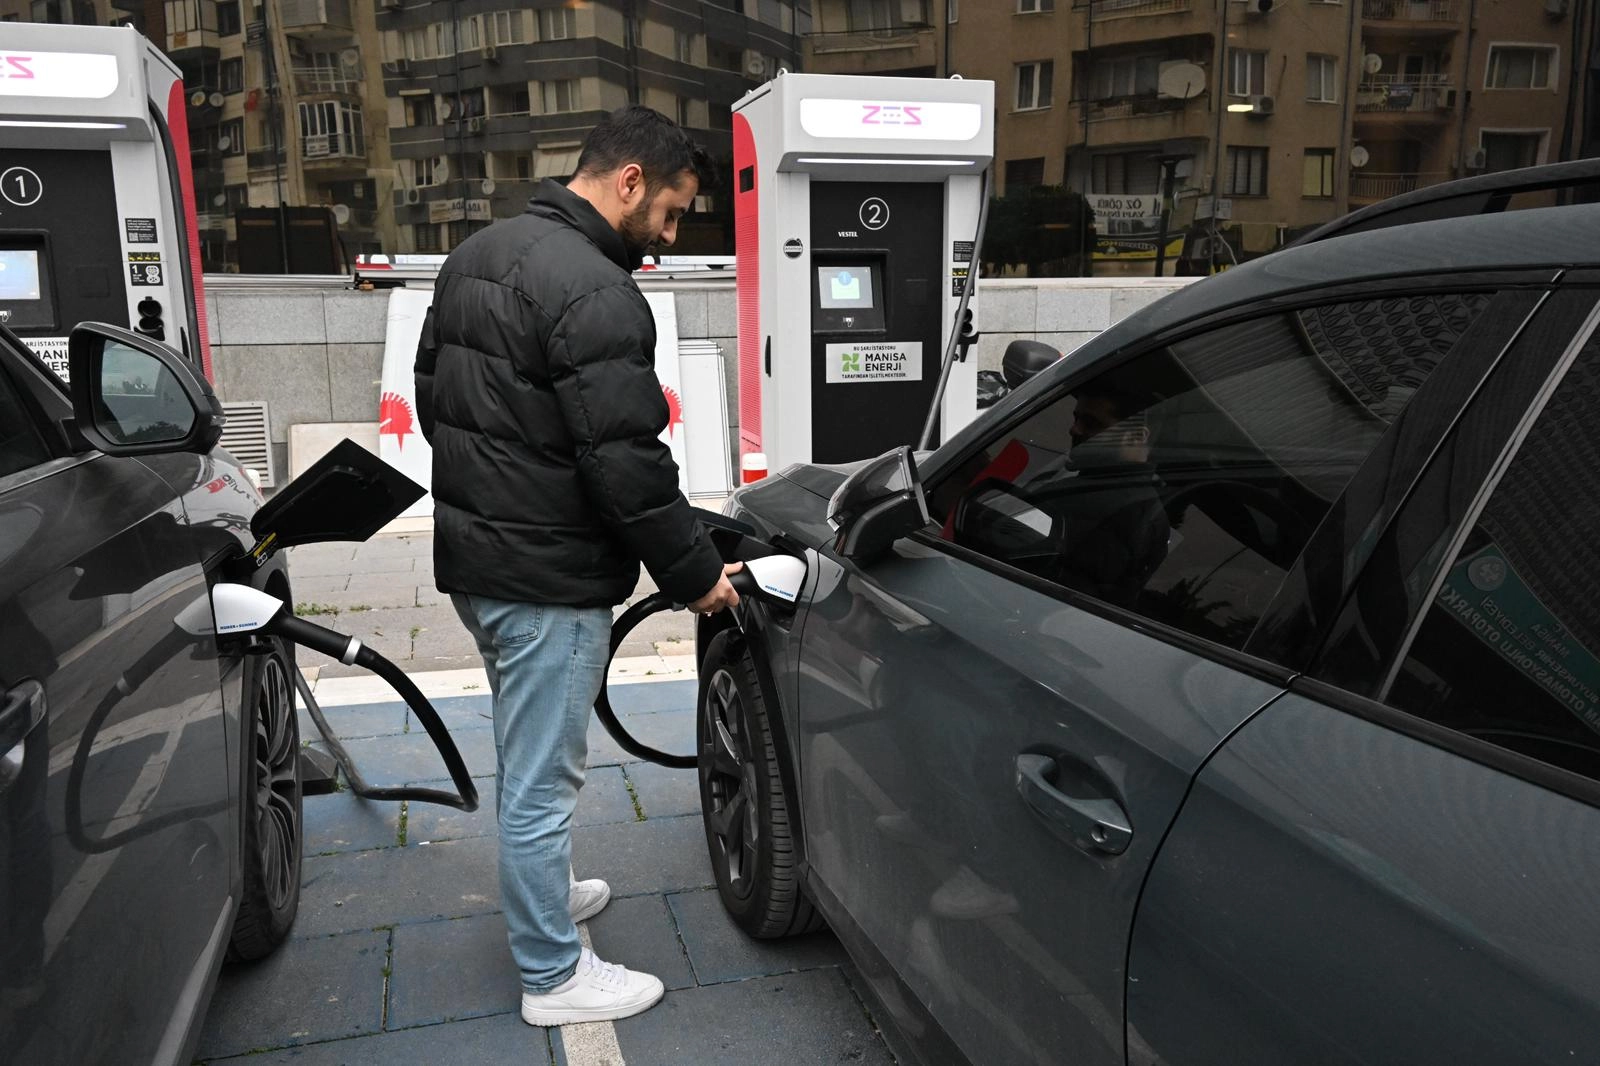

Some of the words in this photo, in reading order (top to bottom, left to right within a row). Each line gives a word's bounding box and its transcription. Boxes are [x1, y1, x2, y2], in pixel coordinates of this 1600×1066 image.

[862, 105, 922, 125] ZES
[15, 175, 26, 198] 1
[868, 204, 881, 223] 2
